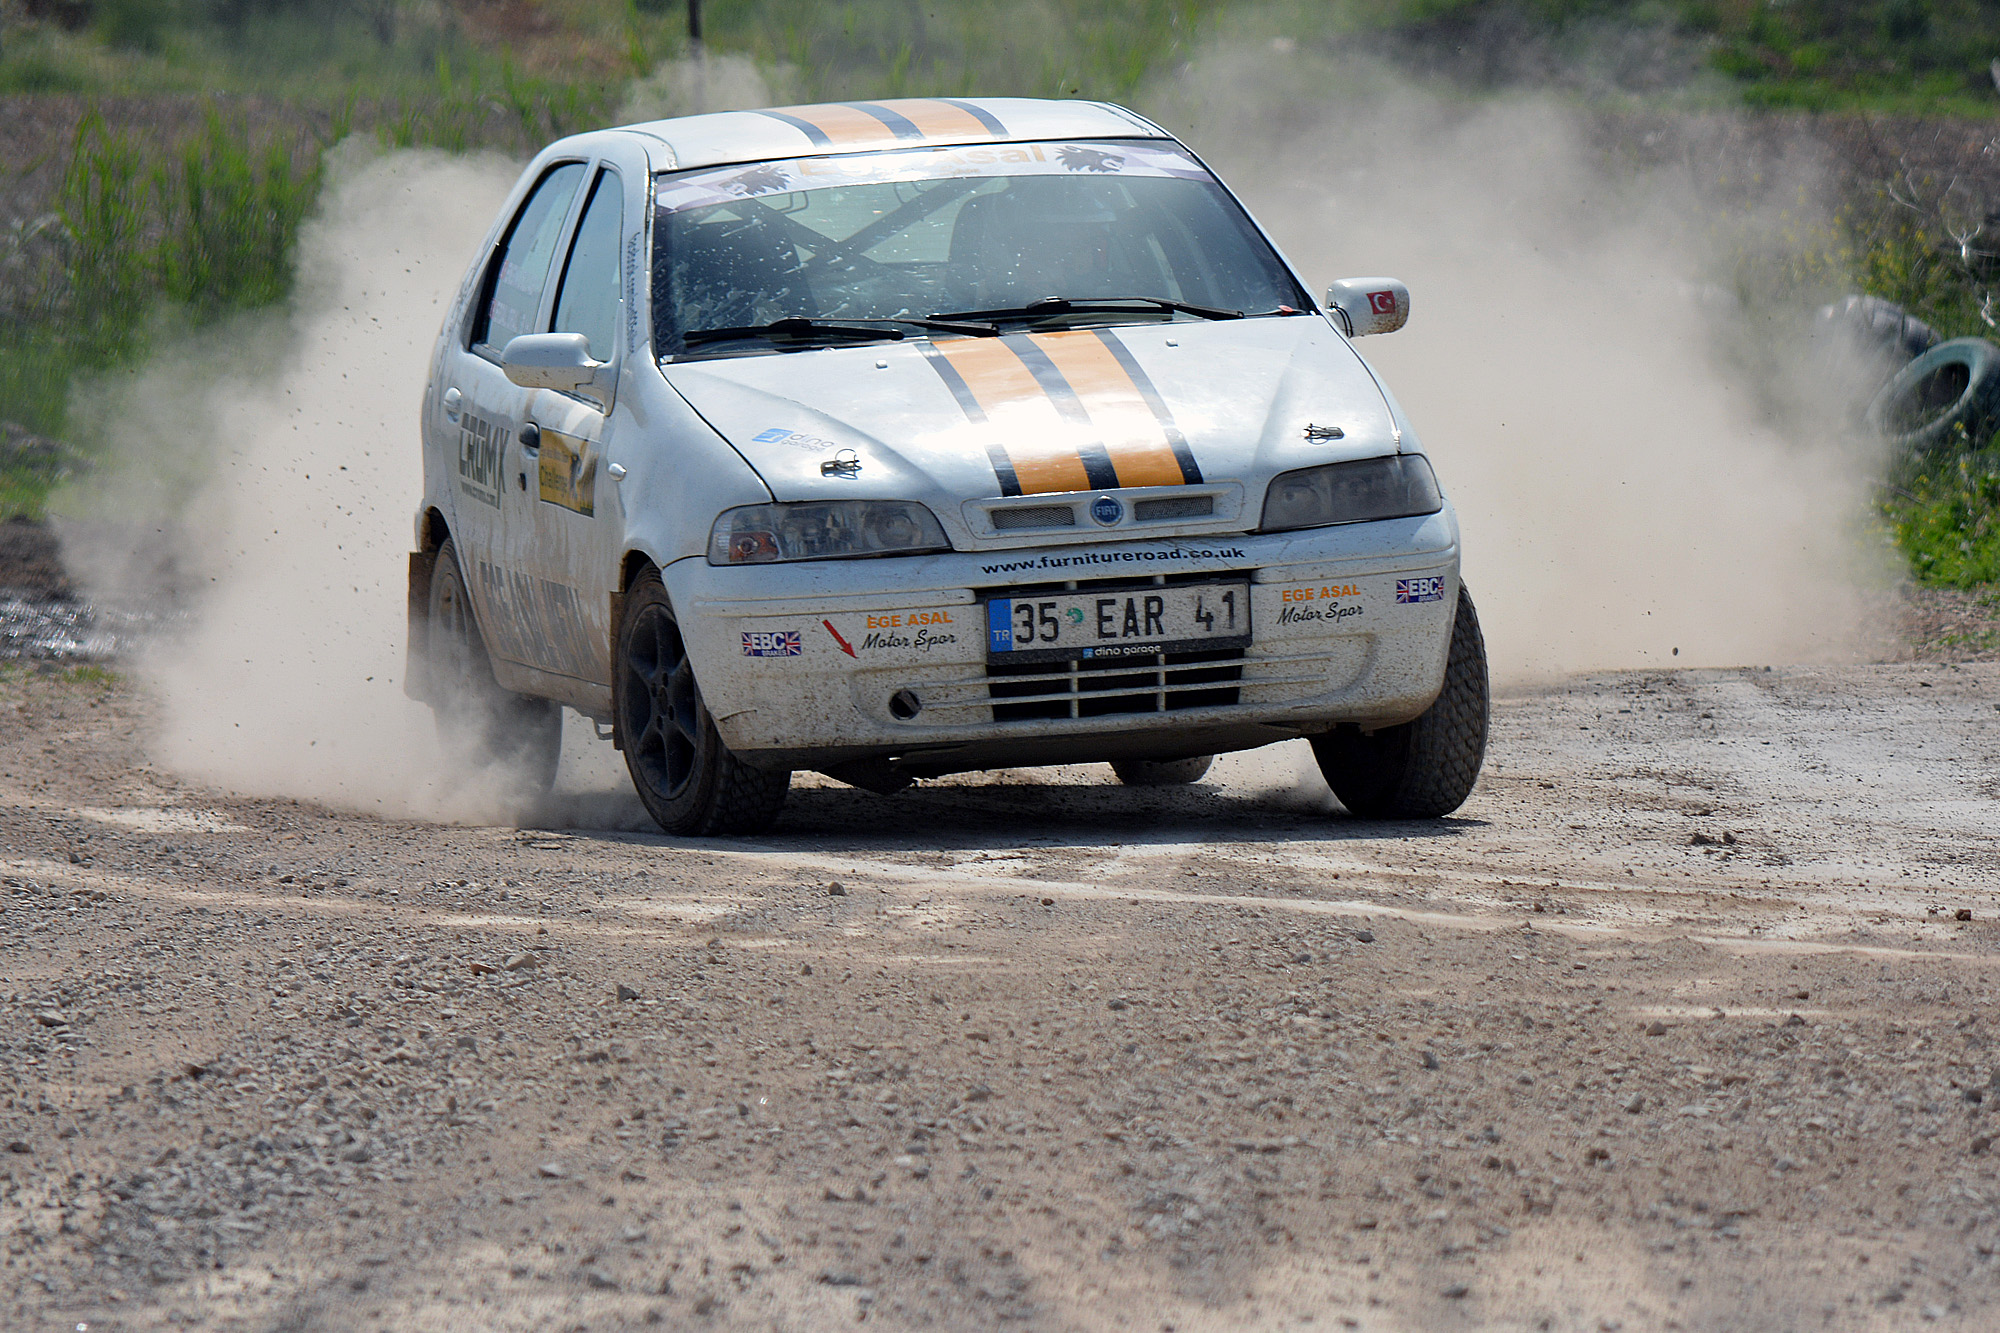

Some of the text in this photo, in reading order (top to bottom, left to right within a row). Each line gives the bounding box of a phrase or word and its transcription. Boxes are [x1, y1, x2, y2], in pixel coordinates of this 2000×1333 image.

[789, 432, 835, 448] dino
[1095, 505, 1117, 516] FIAT
[982, 547, 1246, 574] www.furnitureroad.co.uk
[1282, 584, 1361, 602] EGE ASAL
[1409, 577, 1438, 596] EBC
[867, 611, 953, 629] EGE ASAL
[1014, 590, 1236, 643] 35 EAR 41
[1276, 602, 1364, 625] Motor Spor
[751, 632, 786, 650] EBC
[862, 629, 957, 651] Motor Spor
[993, 630, 1010, 641] TR
[1094, 645, 1161, 656] dino garage
